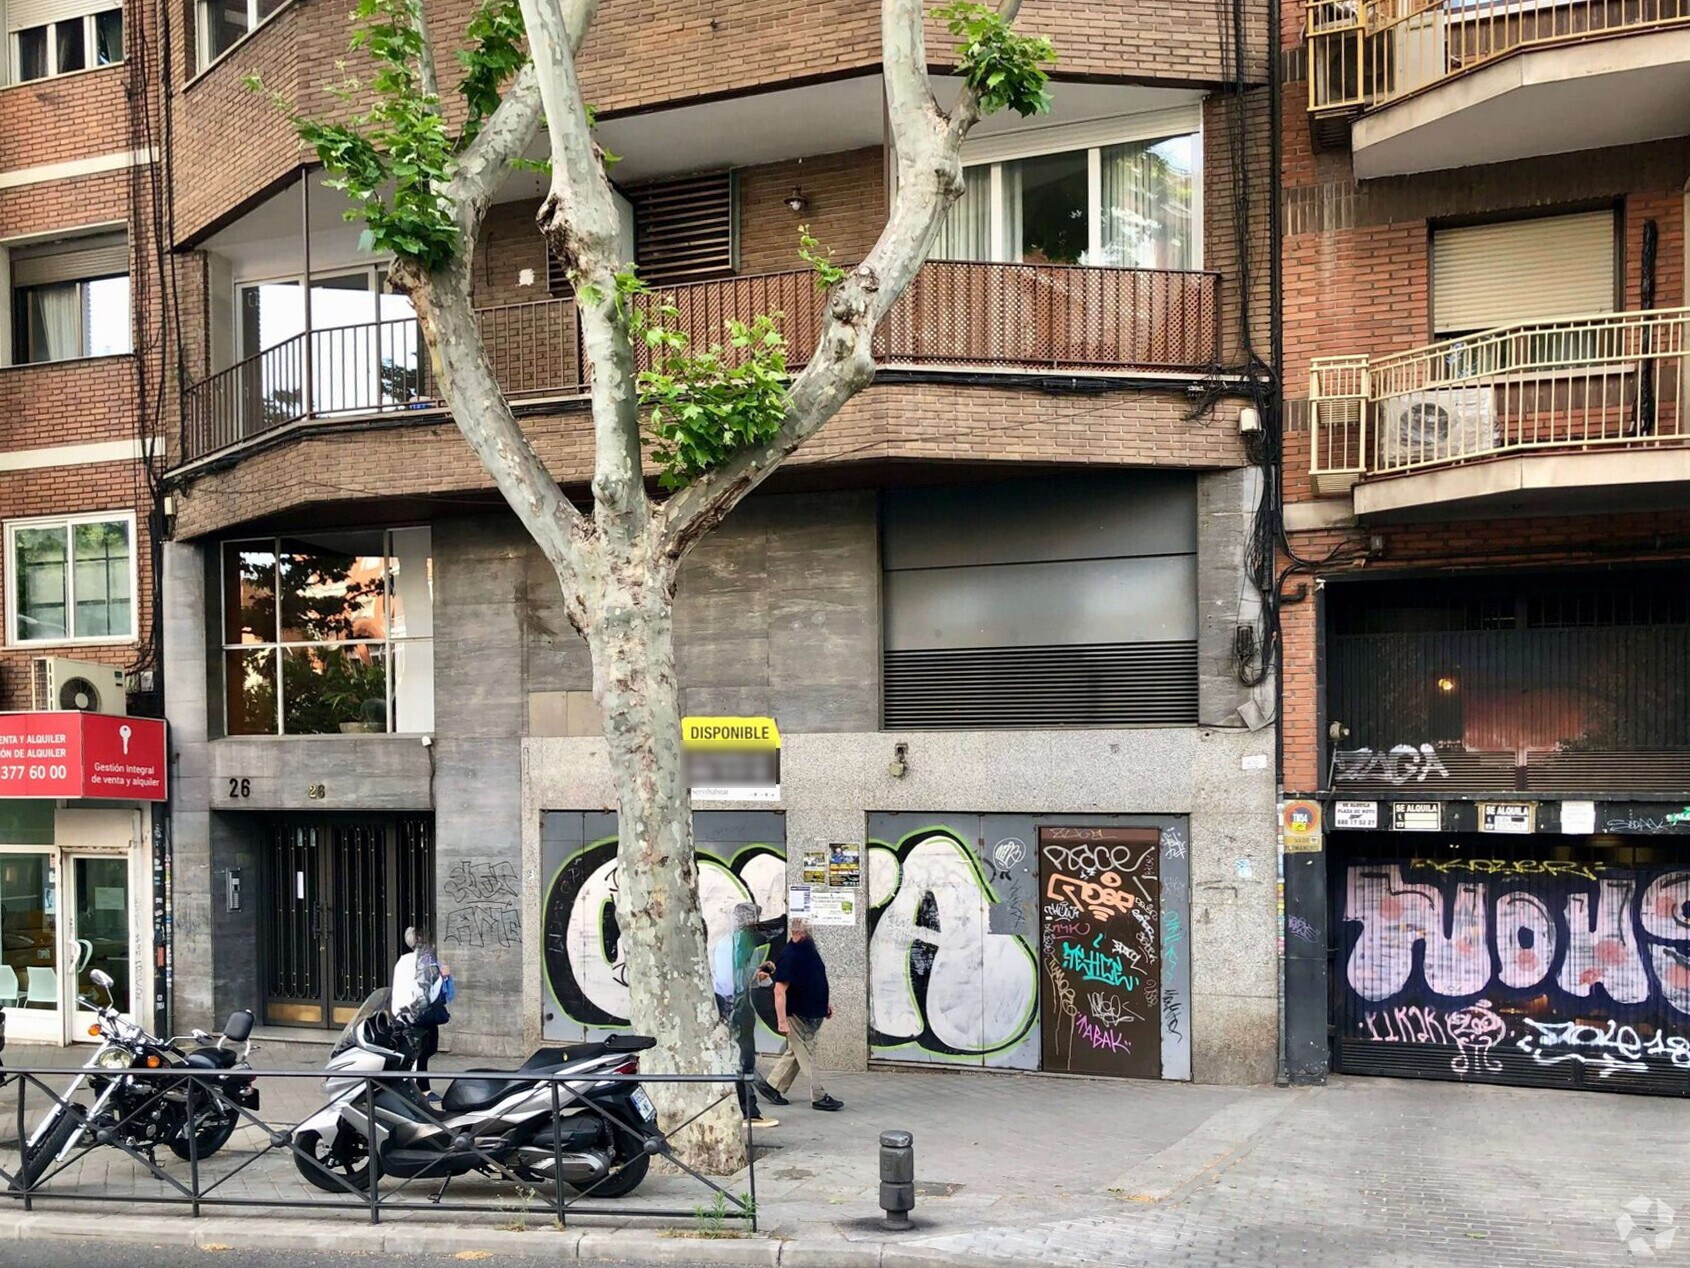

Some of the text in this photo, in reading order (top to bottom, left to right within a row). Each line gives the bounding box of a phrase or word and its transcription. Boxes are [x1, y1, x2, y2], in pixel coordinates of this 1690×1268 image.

[20, 735, 25, 744] Y
[27, 734, 66, 744] ALQUILER
[690, 726, 769, 740] DISPONIBLE
[14, 749, 25, 758] DE
[27, 748, 66, 758] ALQUILER
[1, 765, 67, 780] 377 60 00
[94, 761, 155, 776] Gestión Integral
[91, 774, 160, 788] de venta y alquiler
[229, 778, 250, 798] 26
[1396, 804, 1437, 812] SE ALQUILA
[1486, 806, 1529, 815] SE ALQUILA
